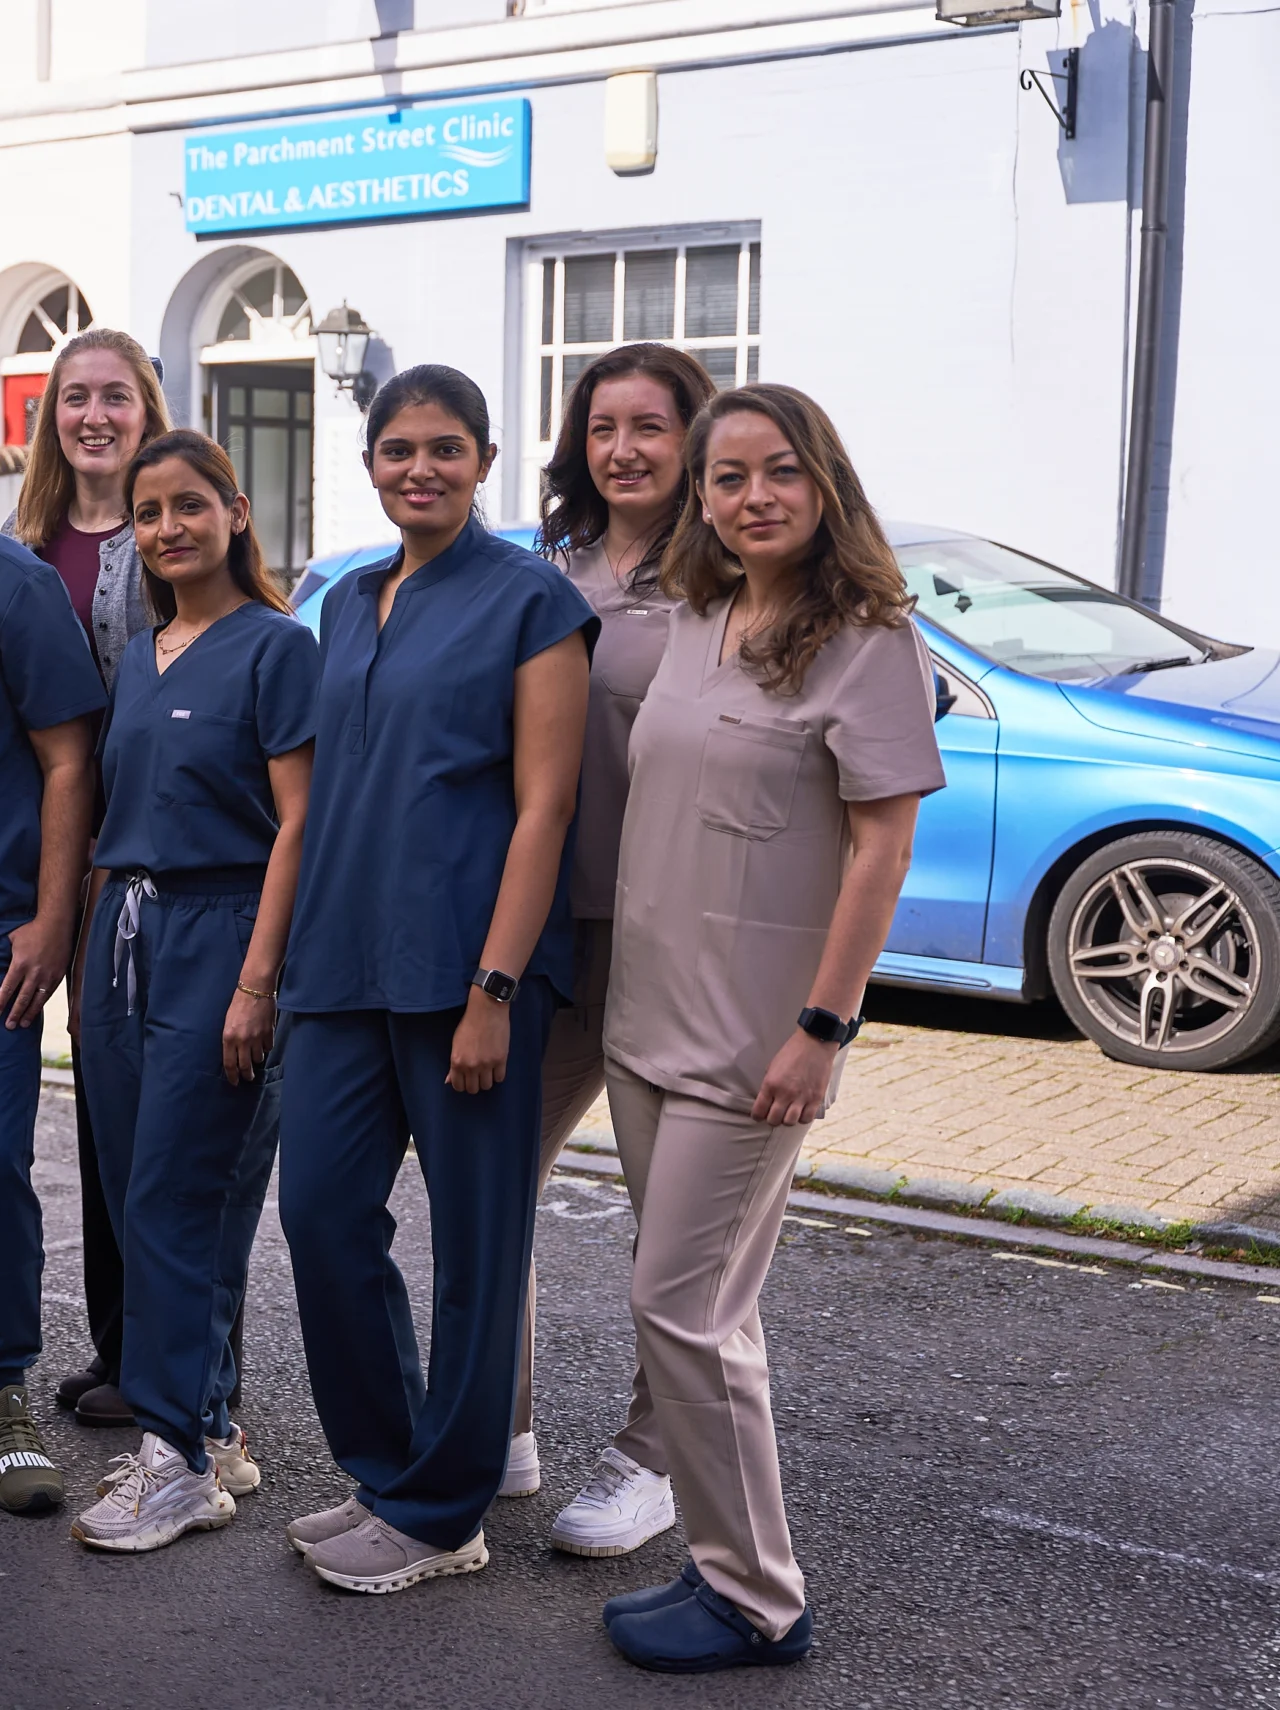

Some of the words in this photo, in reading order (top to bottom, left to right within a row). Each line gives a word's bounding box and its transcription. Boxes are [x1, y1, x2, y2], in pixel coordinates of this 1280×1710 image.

[189, 146, 228, 171] The
[234, 133, 355, 167] Parchment
[362, 124, 436, 152] Street
[443, 112, 514, 143] Clinic
[187, 189, 281, 222] DENTAL
[284, 187, 305, 213] &
[307, 169, 469, 210] AESTHETICS
